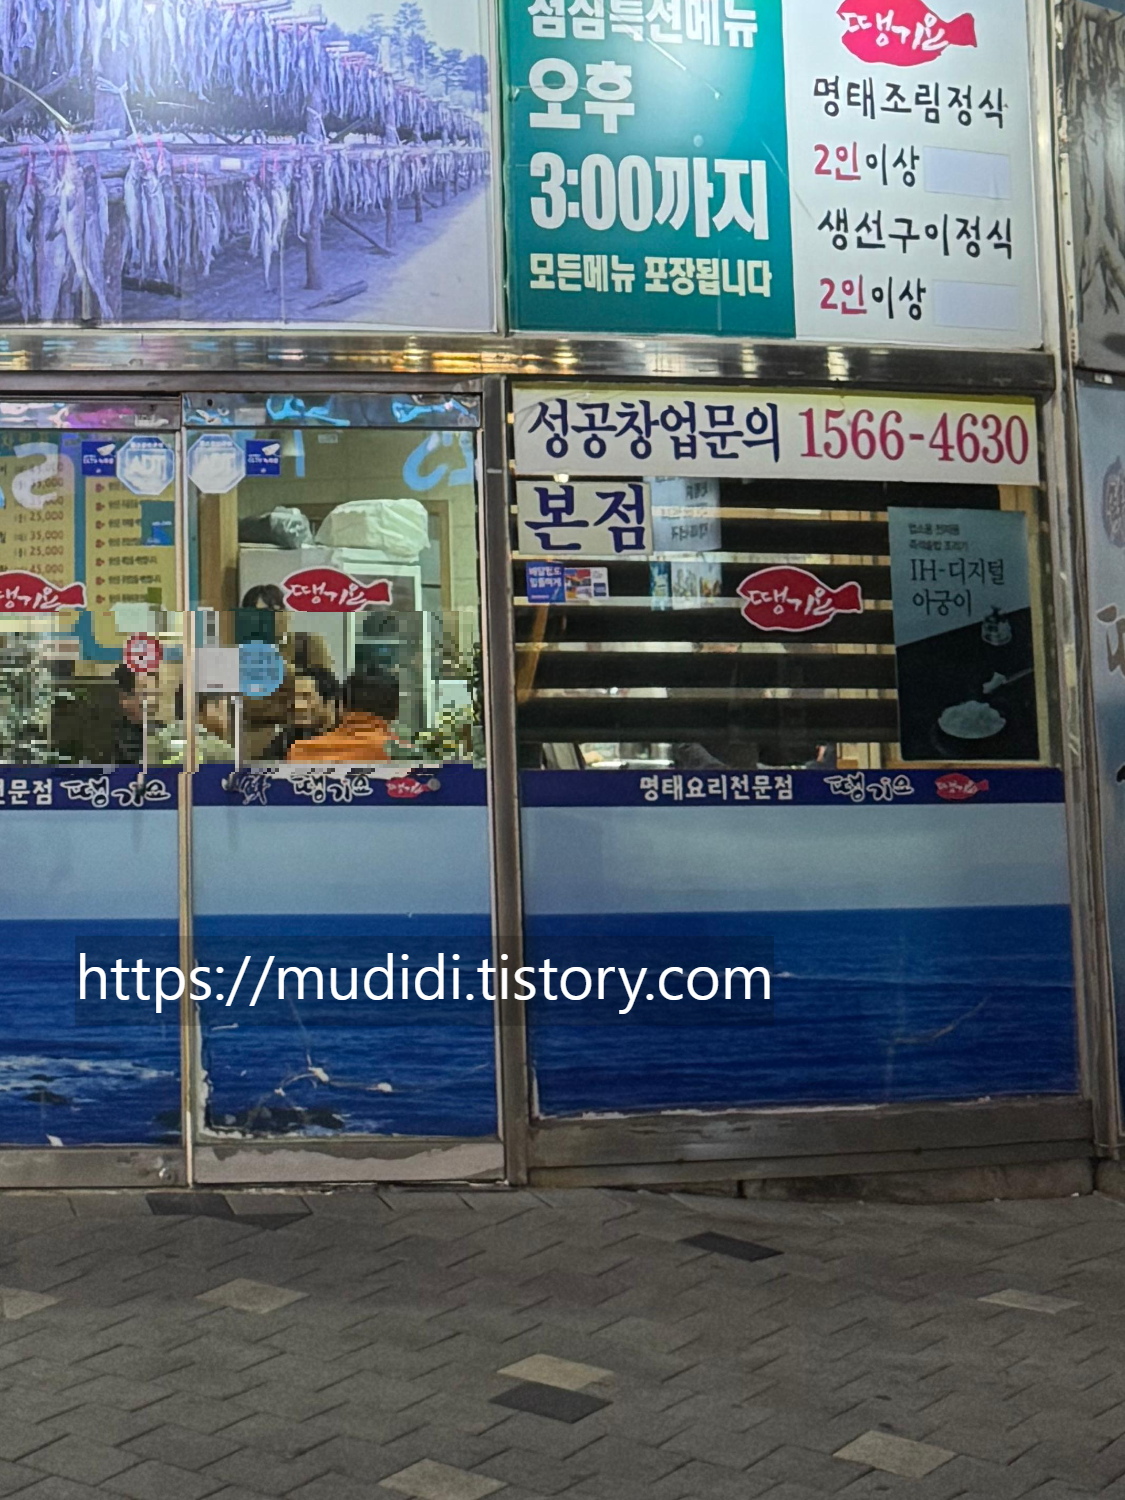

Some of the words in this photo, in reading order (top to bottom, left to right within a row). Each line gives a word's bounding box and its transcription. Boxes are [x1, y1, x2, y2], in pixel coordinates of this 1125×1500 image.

[529, 58, 635, 134] 오후
[813, 76, 1008, 129] 명태조림정식
[529, 153, 770, 241] 3:00까지
[817, 209, 1013, 260] 생선구이정식
[529, 253, 634, 294] 모든메뉴
[644, 256, 772, 298] 포장됩니다
[528, 401, 780, 462] 성공창업문의
[799, 408, 1030, 466] 1566-4630
[525, 483, 646, 553] 본점
[910, 557, 1005, 585] IH-디지털
[913, 589, 971, 616] 아궁이
[639, 774, 793, 801] 명태요리전문점
[823, 772, 914, 801] 땡기요
